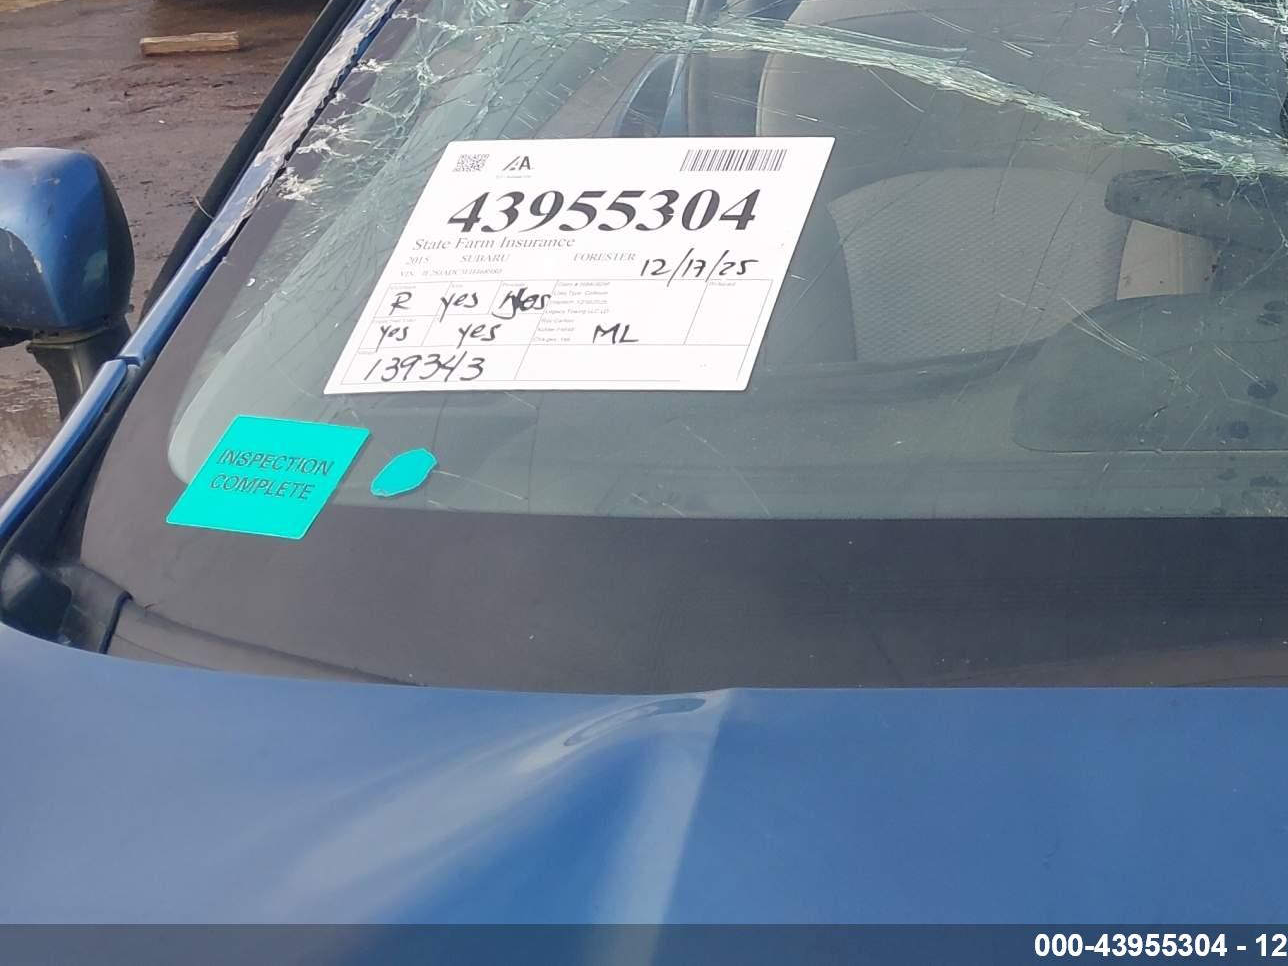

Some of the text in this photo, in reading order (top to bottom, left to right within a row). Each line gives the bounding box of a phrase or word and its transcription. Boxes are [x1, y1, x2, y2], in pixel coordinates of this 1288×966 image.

[447, 189, 761, 233] 43955304
[412, 236, 576, 251] State Farm Insurance
[460, 253, 511, 264] SUBARU
[573, 252, 636, 262] FORESTER
[640, 247, 759, 287] 12/17/25
[388, 291, 412, 316] R
[593, 323, 639, 345] ML
[364, 351, 485, 382] 139343
[216, 449, 336, 476] INSPECTION
[209, 474, 316, 501] COMPLETE
